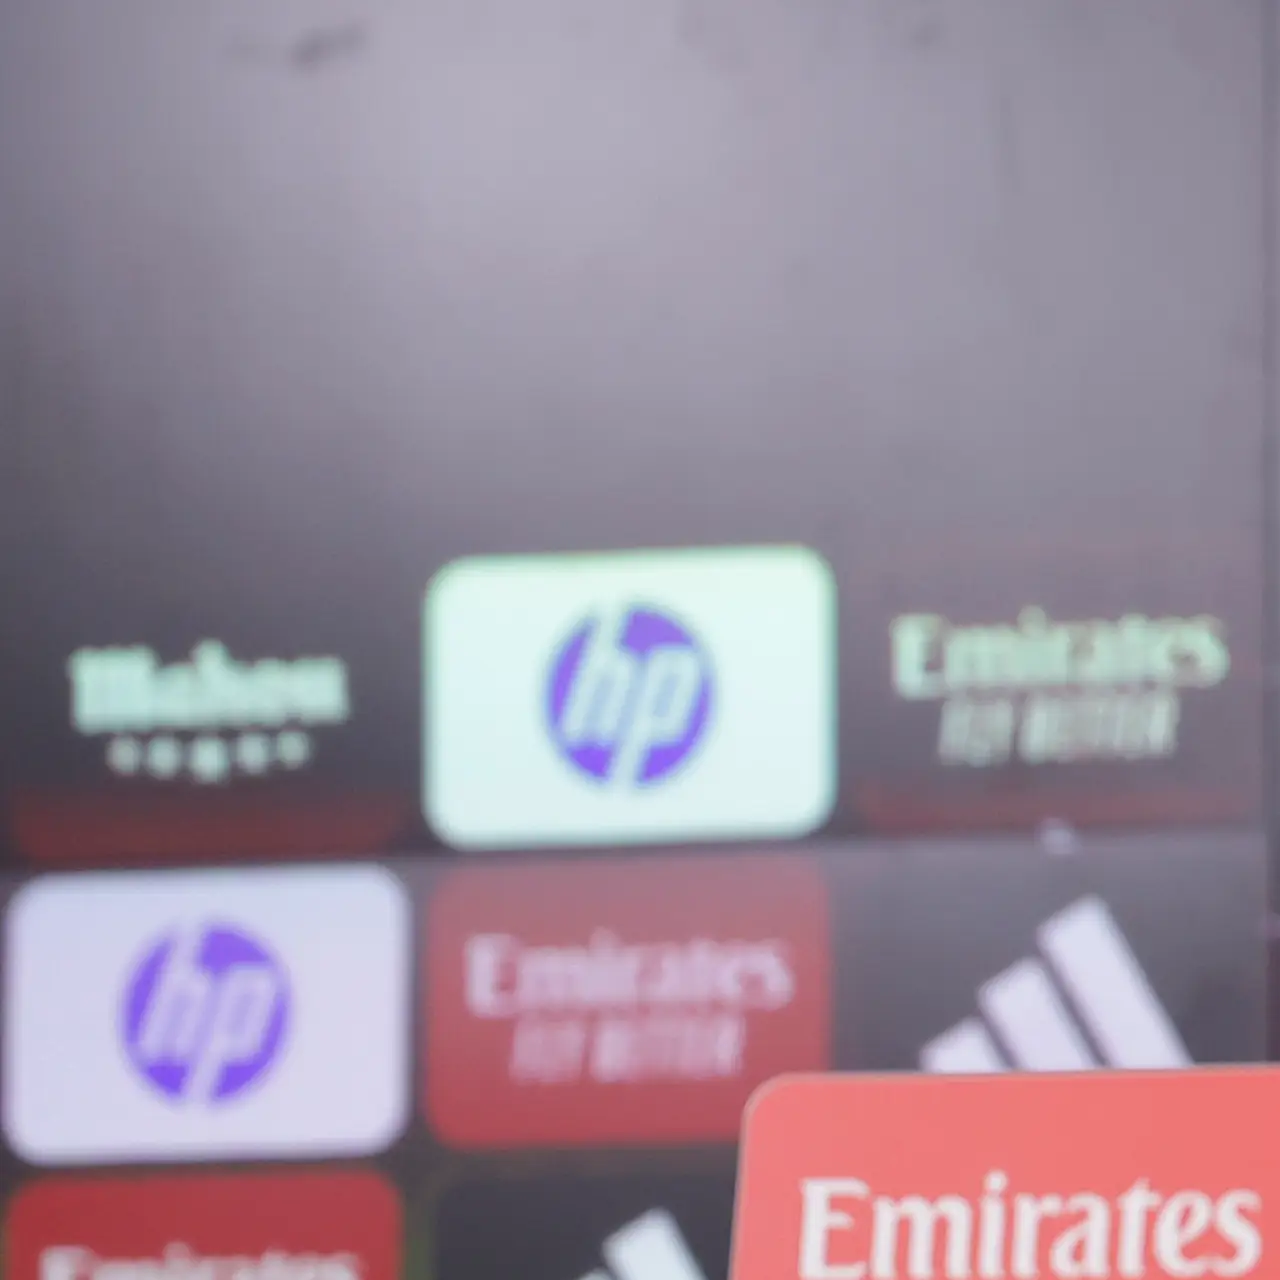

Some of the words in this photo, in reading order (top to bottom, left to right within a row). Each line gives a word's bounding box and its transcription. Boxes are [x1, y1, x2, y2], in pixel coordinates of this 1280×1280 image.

[558, 602, 704, 787] hp
[888, 607, 1230, 699] Emirates
[133, 922, 279, 1105] hp
[464, 930, 795, 1017] Emirates
